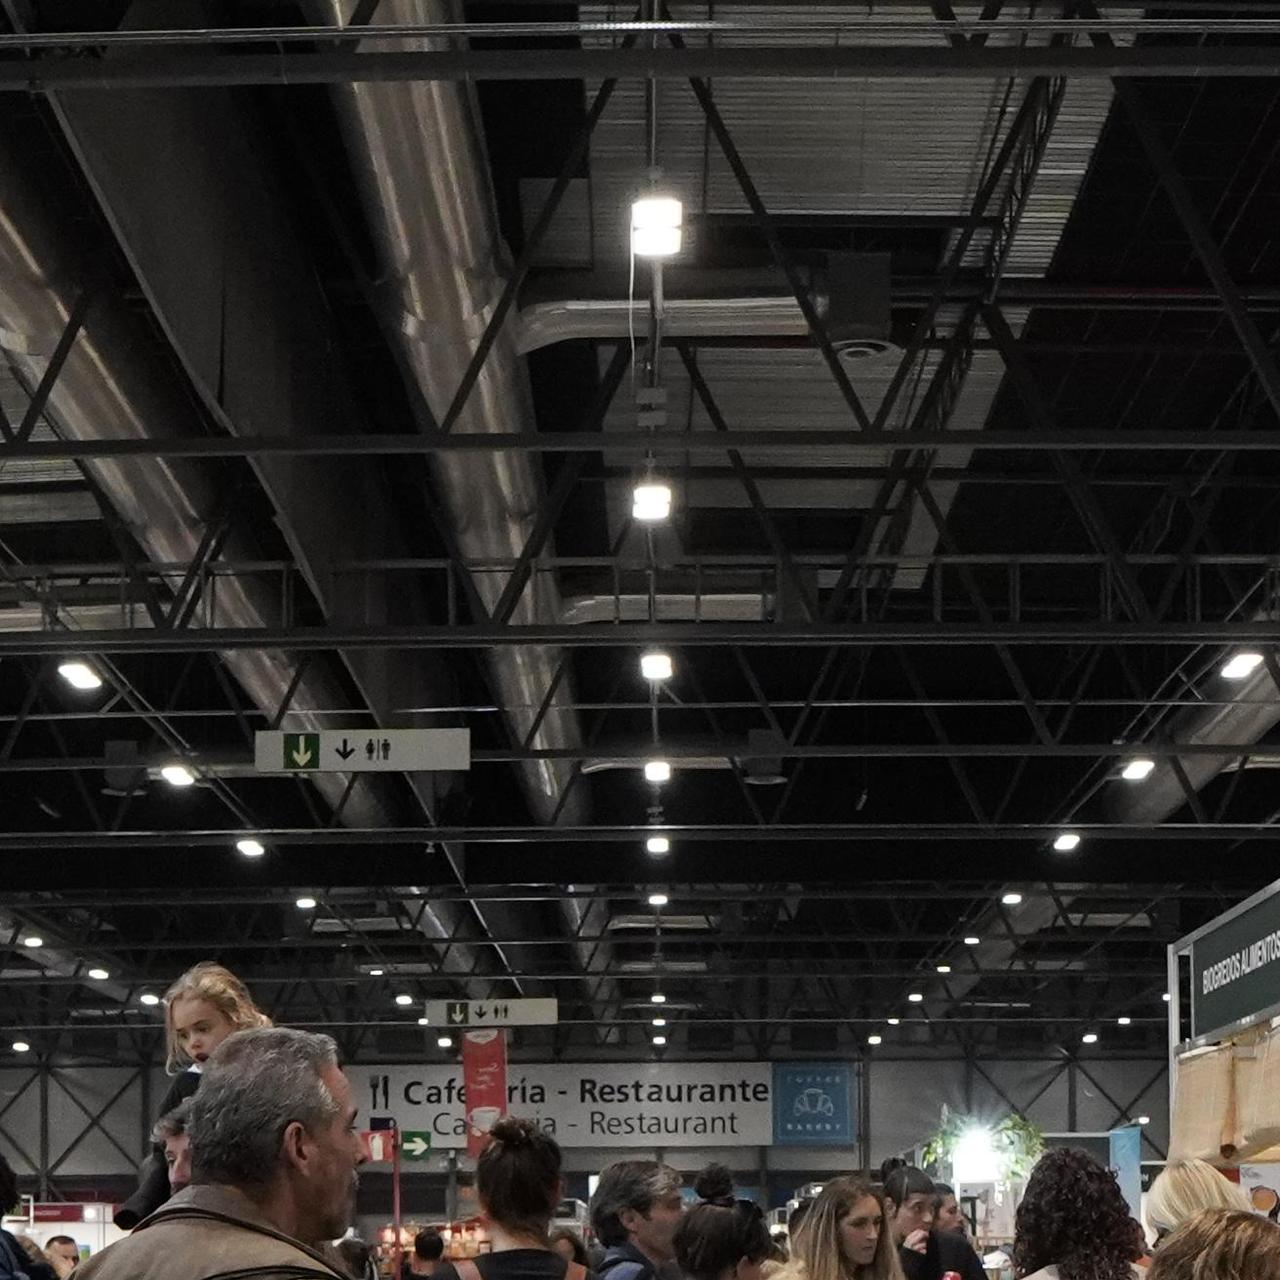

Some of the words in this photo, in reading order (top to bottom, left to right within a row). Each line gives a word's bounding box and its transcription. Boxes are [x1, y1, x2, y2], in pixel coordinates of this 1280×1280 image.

[404, 1077, 546, 1105] Cafería
[579, 1078, 769, 1103] Restaurante
[590, 1111, 738, 1135] Restaurant
